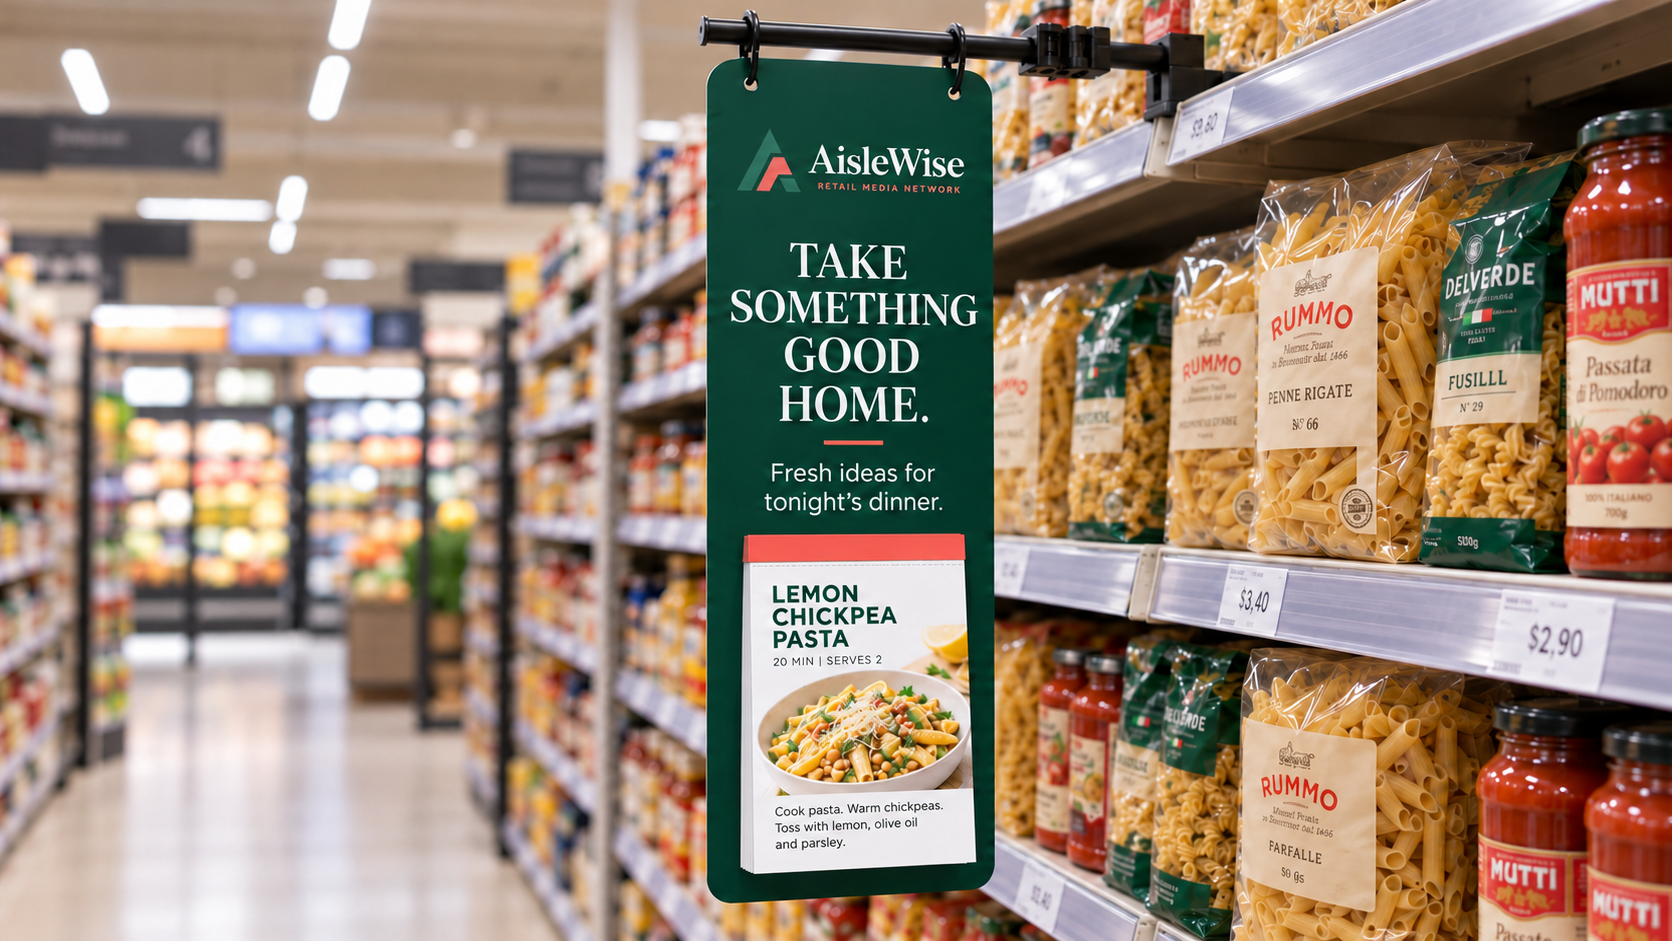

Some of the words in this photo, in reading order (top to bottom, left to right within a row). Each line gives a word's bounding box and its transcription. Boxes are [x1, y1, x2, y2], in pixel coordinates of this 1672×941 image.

[808, 144, 965, 178] AisleWise
[817, 182, 857, 192] RETAIL
[862, 183, 899, 192] MEDIA
[904, 184, 961, 194] NETWORK
[789, 242, 907, 280] TAKE
[1445, 262, 1535, 300] DELVERDE
[1581, 278, 1658, 310] MUTTI
[730, 289, 979, 327] SOMETHING
[1270, 300, 1353, 341] RUMMO
[784, 336, 919, 374] GOOD
[1586, 354, 1651, 378] Passata
[1182, 353, 1242, 383] RUMMO
[1268, 388, 1301, 405] PENNE
[1304, 383, 1353, 401] RIGATE
[1576, 383, 1586, 403] di
[1589, 379, 1668, 403] Pomodoro
[779, 385, 929, 423] HOME.
[1472, 401, 1484, 413] 29
[1306, 417, 1319, 431] 66
[771, 463, 832, 482] Fresh
[840, 463, 898, 482] ideas
[905, 462, 936, 482] for
[764, 491, 862, 516] tonight’s
[869, 491, 943, 511] dinner.
[1585, 494, 1605, 503] 100%
[1607, 493, 1653, 503] ITALIANO
[1605, 508, 1628, 521] 700g
[772, 584, 858, 604] LEMON
[1239, 587, 1270, 615] $3,40
[772, 606, 897, 626] CHICKPEA
[773, 629, 849, 649] PASTA
[1528, 622, 1583, 660] $2,90
[773, 657, 788, 667] 20
[792, 657, 814, 666] MIN
[826, 655, 871, 666] SERVES
[875, 655, 882, 664] 2
[1261, 773, 1338, 811] RUMMO
[775, 806, 805, 817] Cook
[808, 805, 844, 818] pasta.
[847, 804, 881, 814] Warm
[884, 801, 944, 815] chickpeas.
[775, 822, 801, 833] Toss
[804, 821, 829, 832] with
[832, 820, 871, 832] lemon,
[874, 818, 901, 829] olive
[904, 817, 918, 828] oil
[775, 839, 798, 850] and
[801, 837, 846, 851] parsley.
[1268, 840, 1323, 865] FARFALLE
[1491, 857, 1557, 891] MUTTI
[1593, 889, 1661, 930] MUTTI
